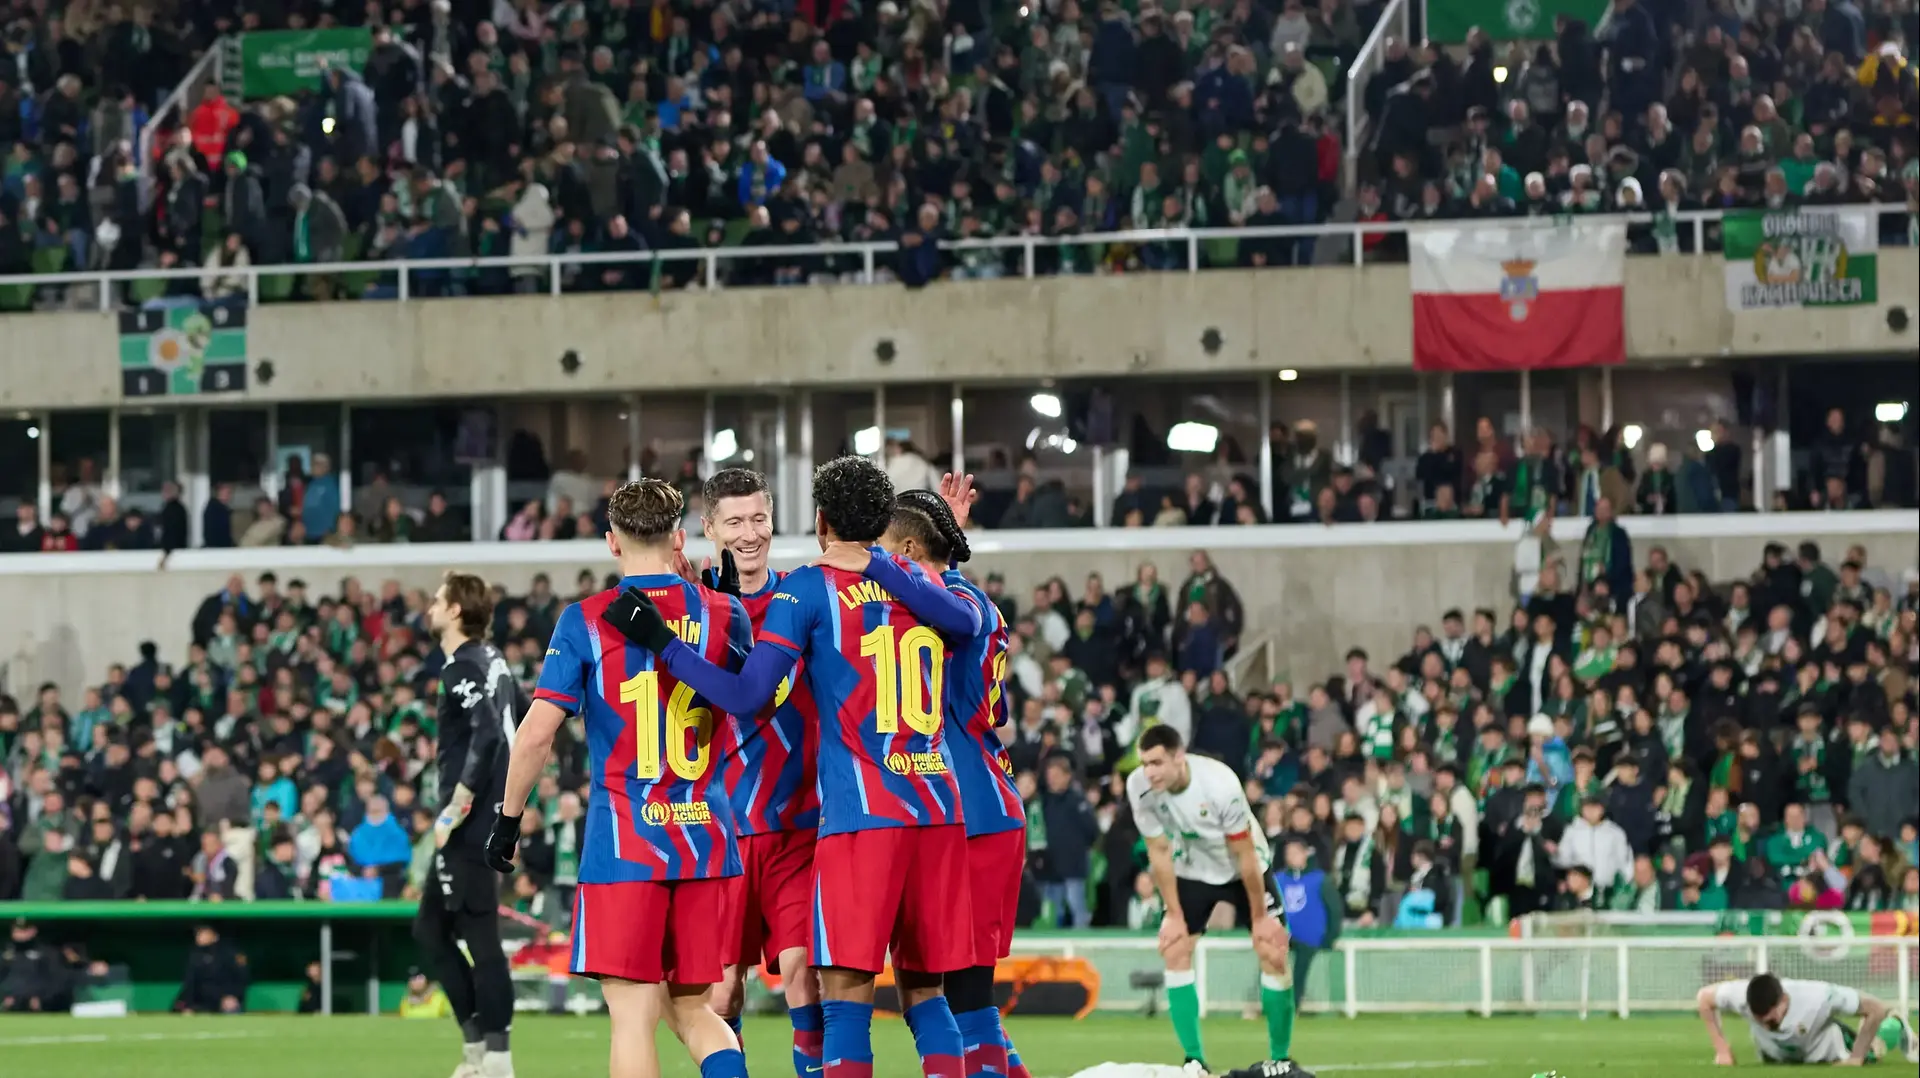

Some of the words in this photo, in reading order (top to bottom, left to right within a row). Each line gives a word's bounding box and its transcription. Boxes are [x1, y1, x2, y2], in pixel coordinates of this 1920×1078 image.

[860, 625, 945, 736] 10
[619, 671, 713, 781] 16
[911, 752, 943, 763] UNHCR
[914, 761, 947, 772] ACNUR
[670, 801, 709, 812] UNHCR
[673, 810, 711, 822] ACNUR
